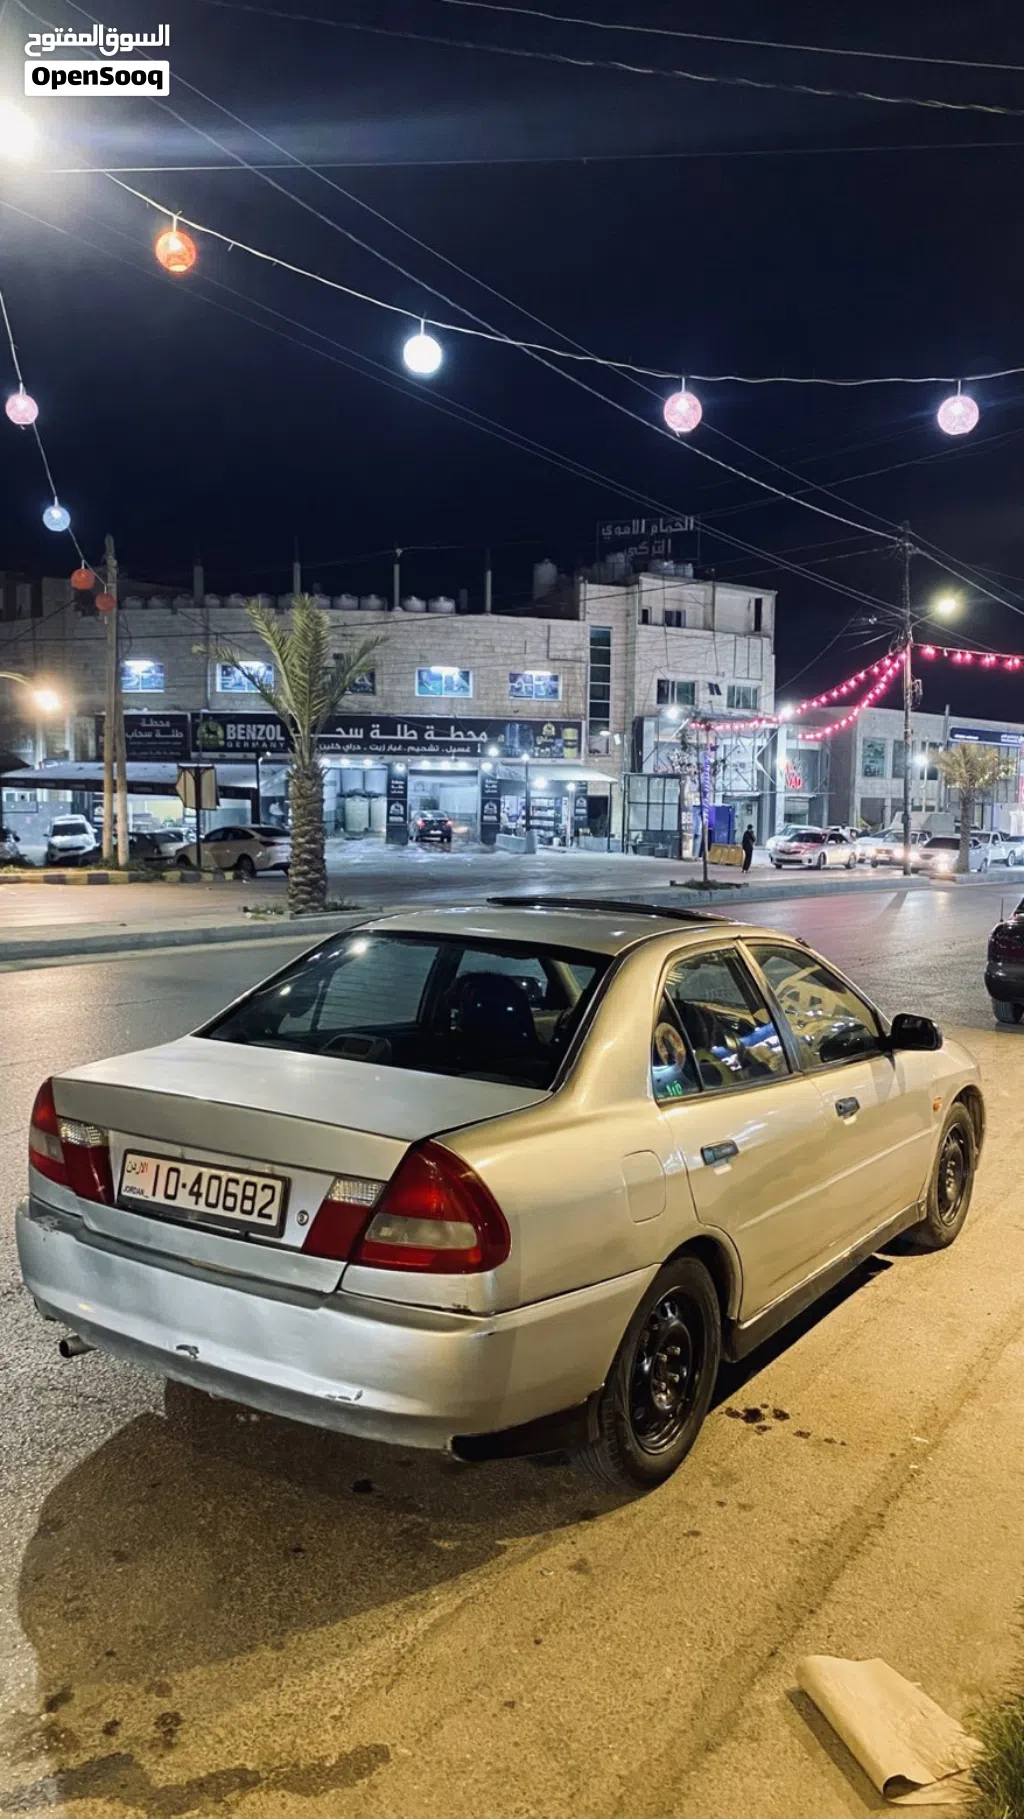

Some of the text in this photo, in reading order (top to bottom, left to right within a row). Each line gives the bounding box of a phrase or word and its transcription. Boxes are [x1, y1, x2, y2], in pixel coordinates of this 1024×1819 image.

[650, 516, 694, 536] الحمام
[141, 717, 171, 728] محطة
[125, 729, 184, 740] طلة سحاب
[226, 724, 285, 741] BENZOL
[370, 724, 418, 740] طلة
[424, 725, 488, 742] محطة
[226, 741, 285, 749] GERMANY
[123, 1184, 144, 1196] JORDAN
[152, 1164, 276, 1220] 10-40682
